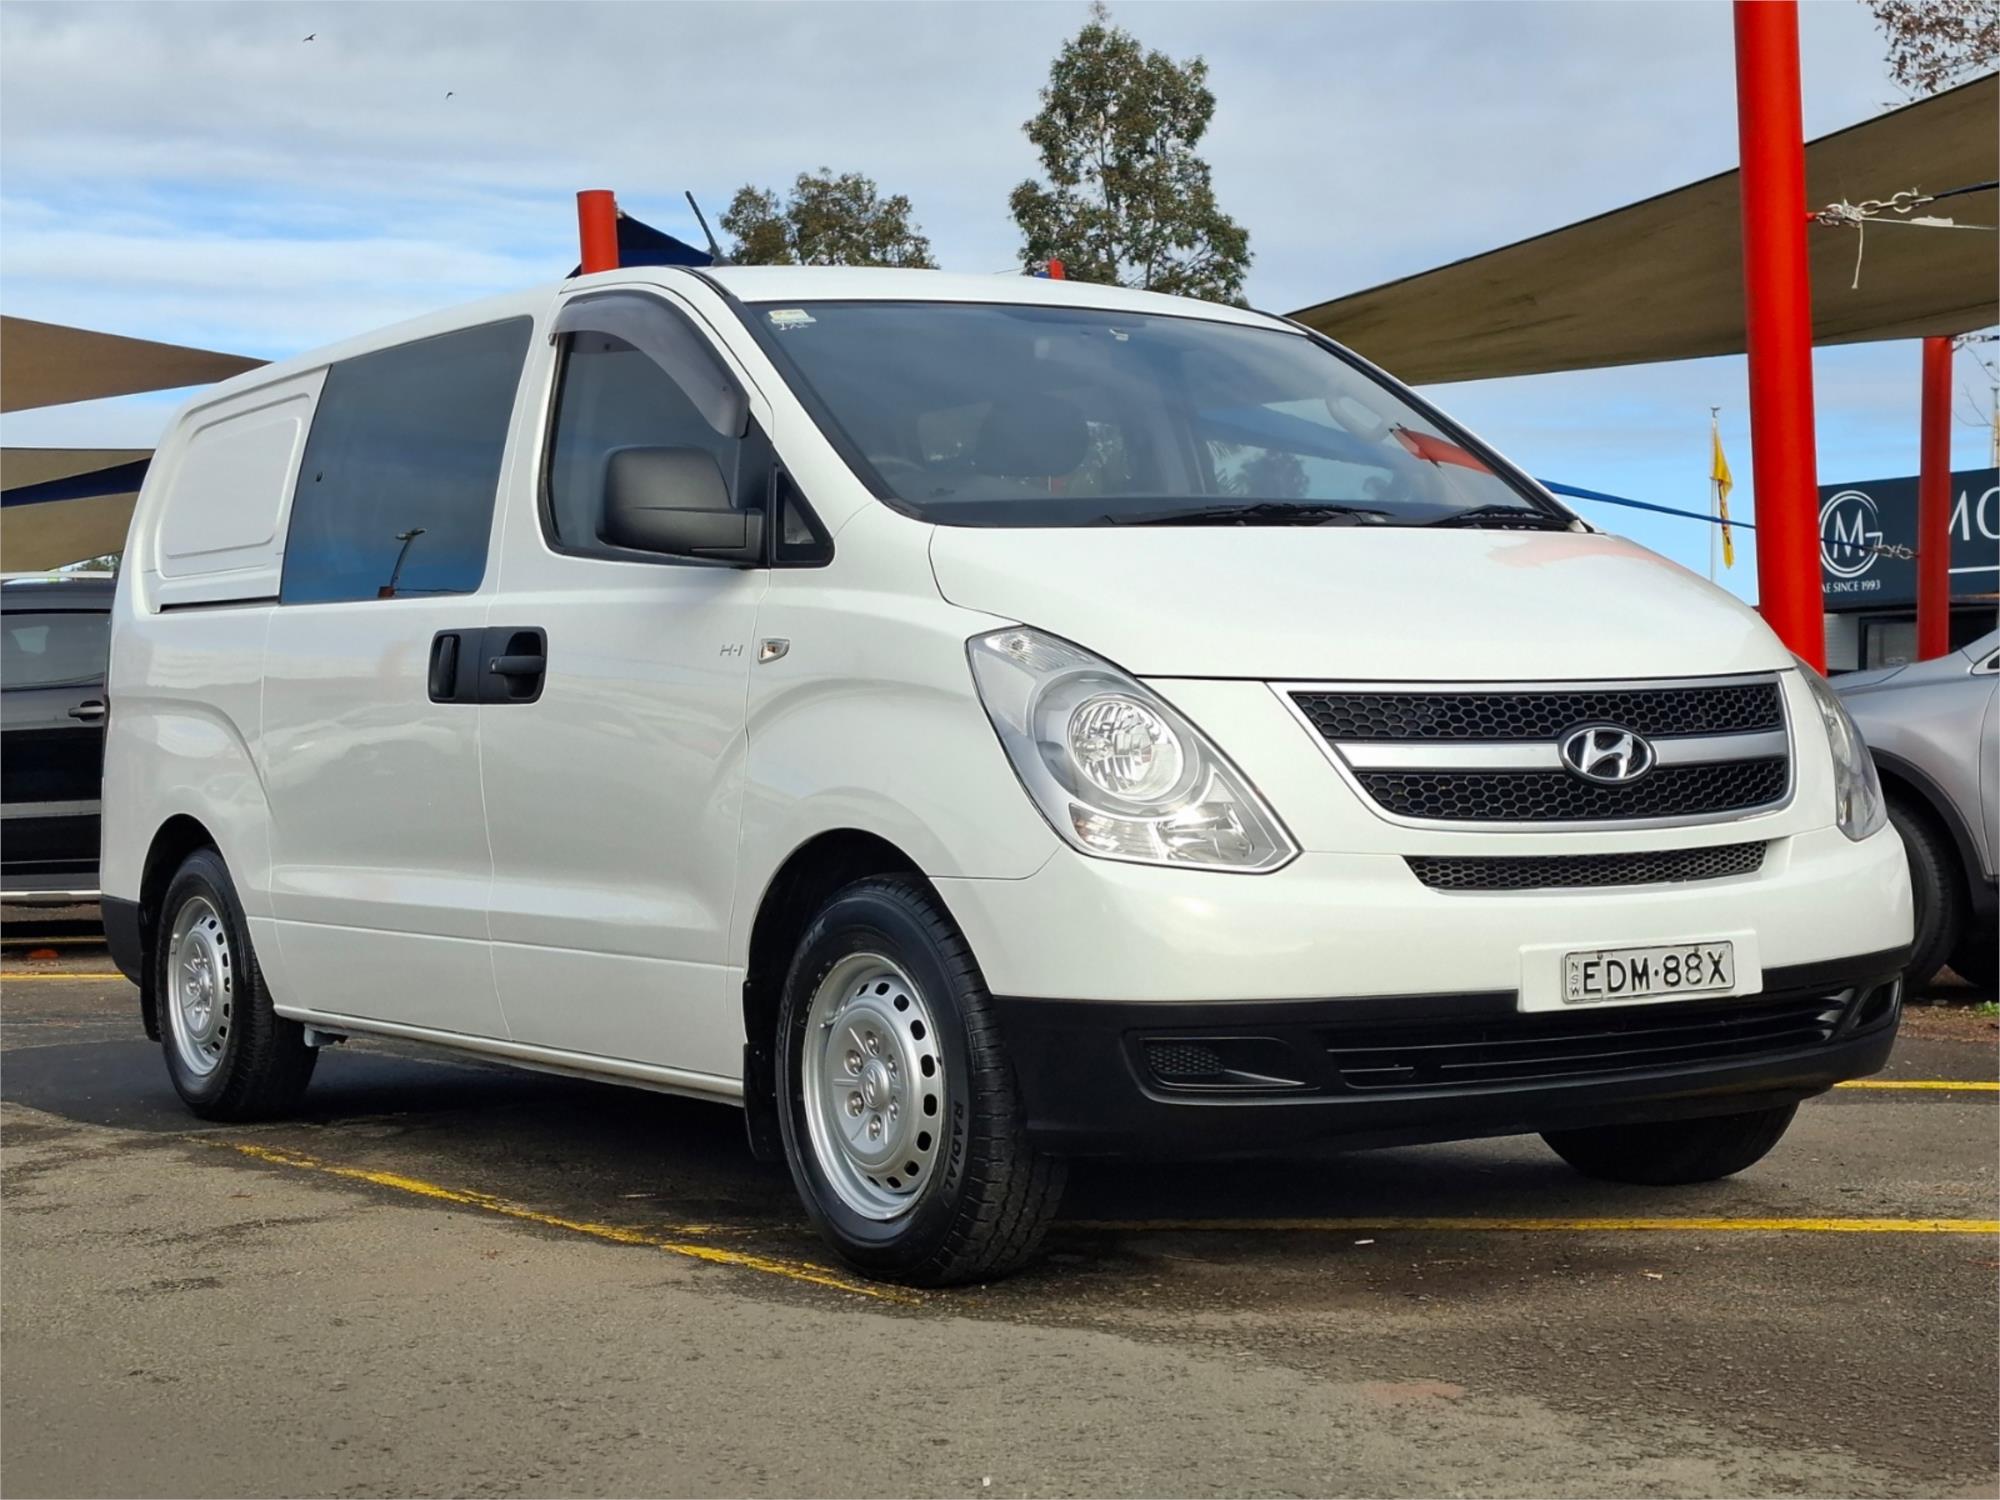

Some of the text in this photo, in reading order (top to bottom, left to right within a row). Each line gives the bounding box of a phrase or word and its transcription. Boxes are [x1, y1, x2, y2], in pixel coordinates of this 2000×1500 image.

[1833, 580, 1858, 592] SINCE
[1861, 579, 1880, 591] 1993
[943, 1100, 965, 1190] RADIAL
